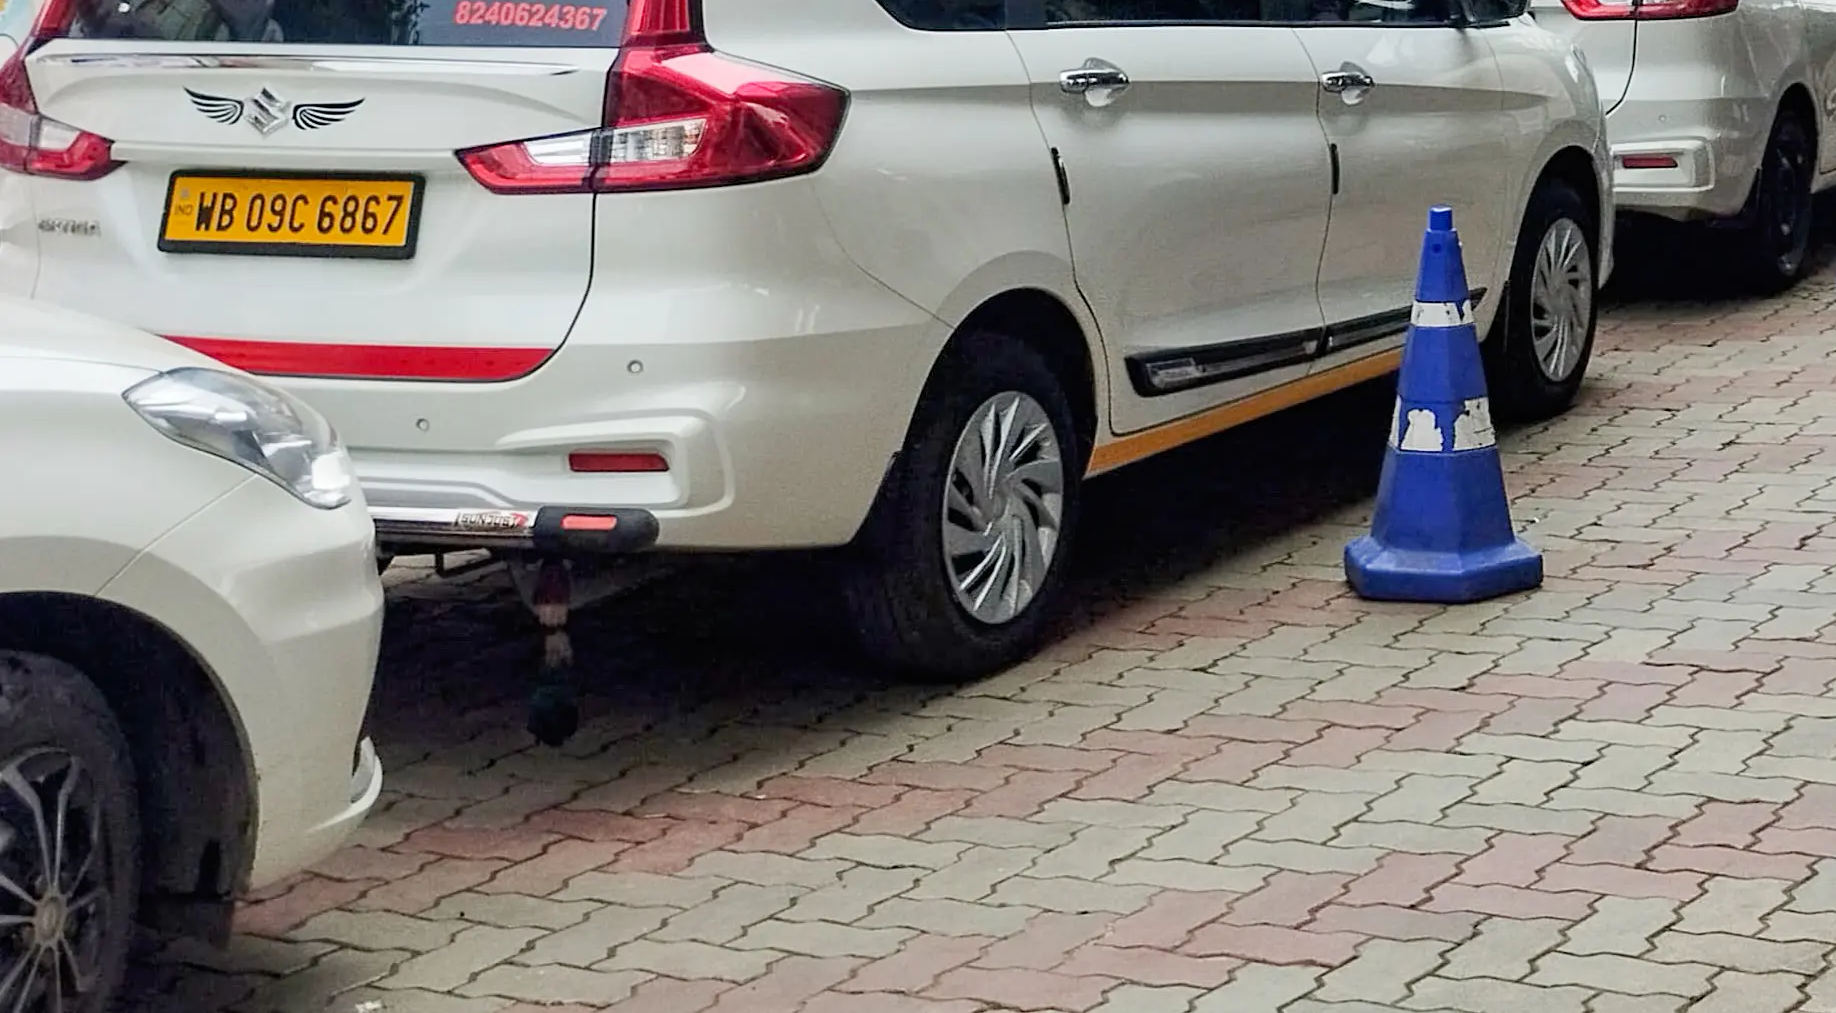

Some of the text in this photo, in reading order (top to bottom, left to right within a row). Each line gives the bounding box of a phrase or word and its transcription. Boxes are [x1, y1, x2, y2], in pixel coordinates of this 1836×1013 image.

[455, 0, 608, 31] 8240624367
[174, 203, 193, 216] IND
[195, 191, 405, 235] WB 09C 6867
